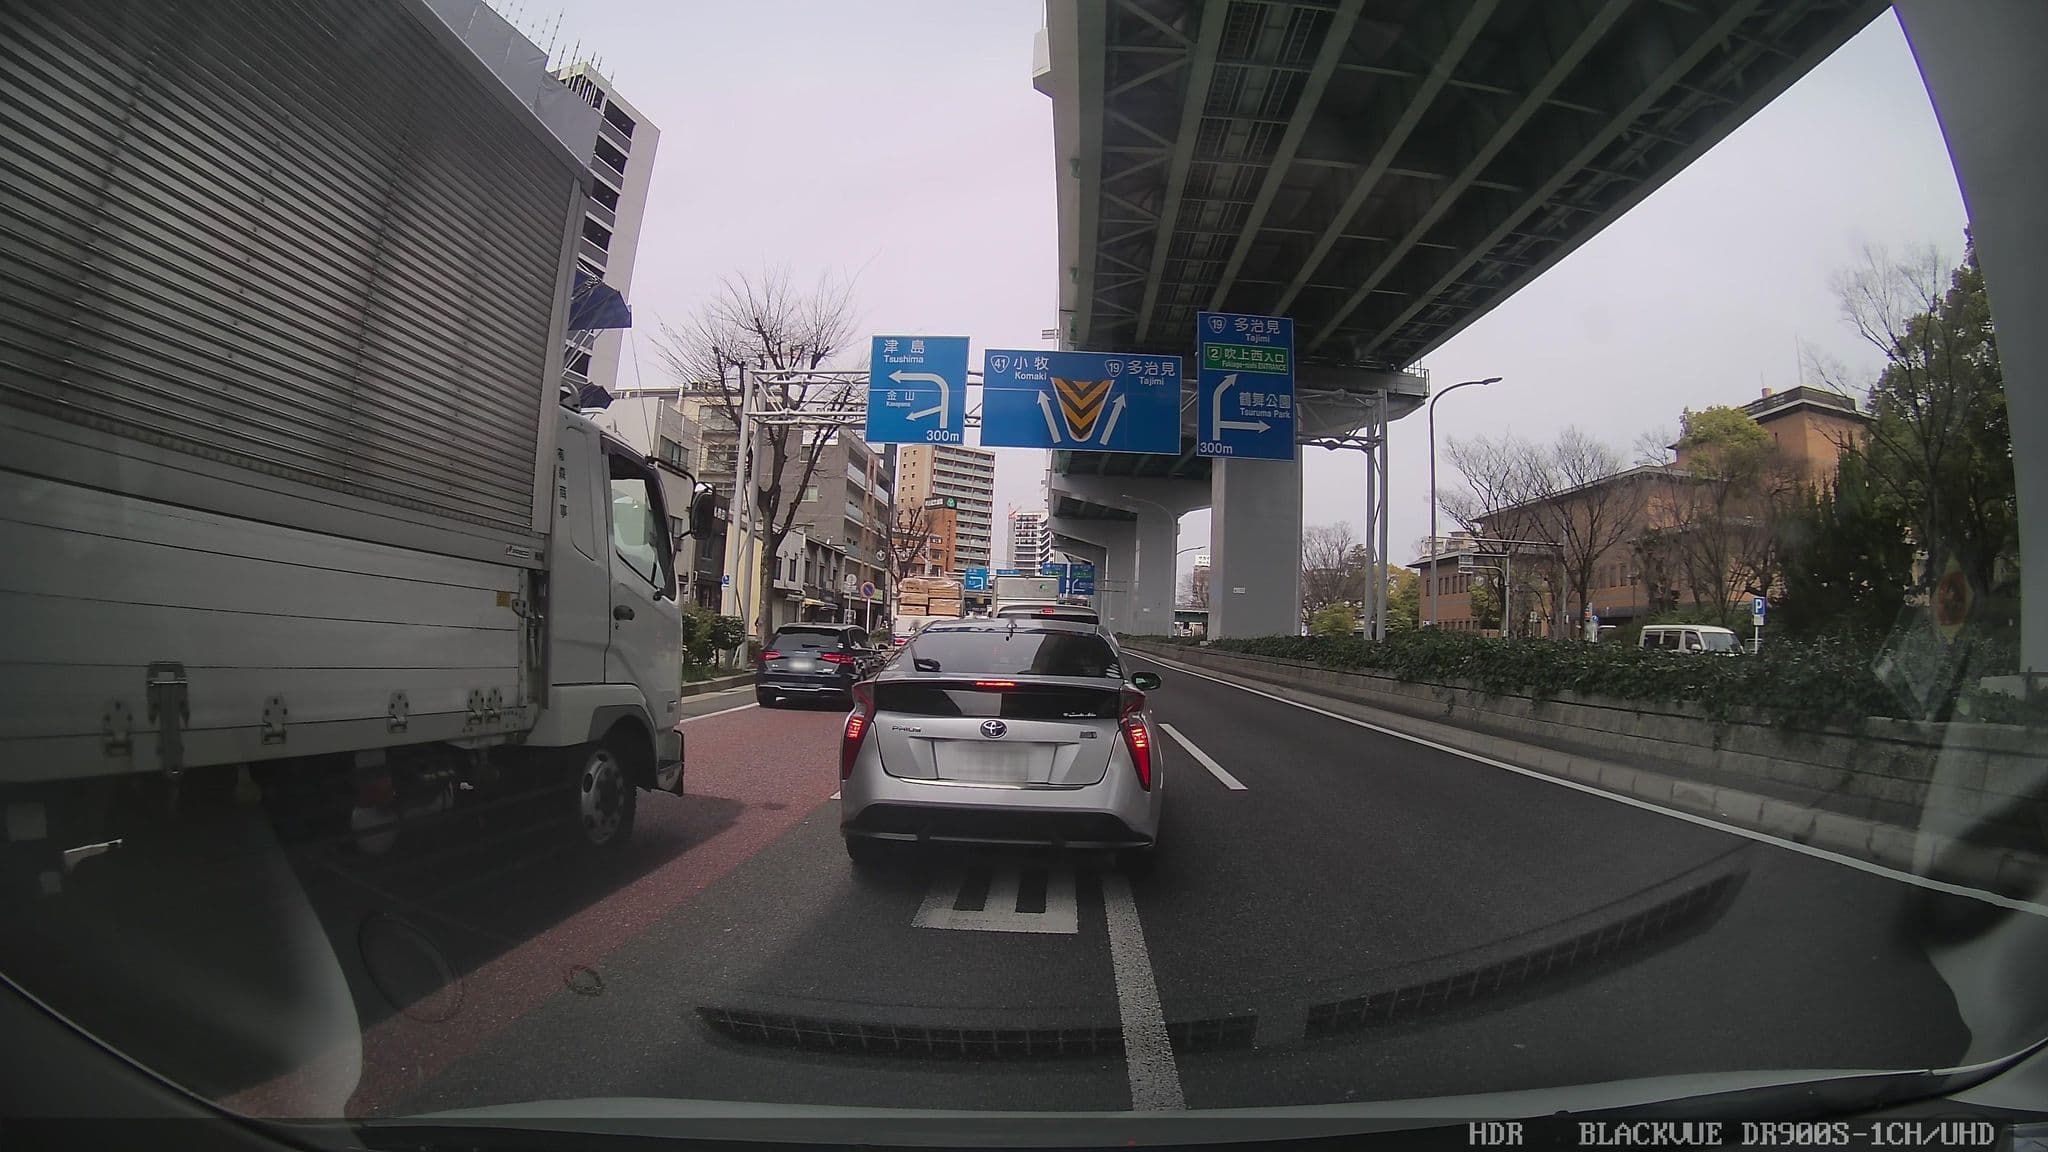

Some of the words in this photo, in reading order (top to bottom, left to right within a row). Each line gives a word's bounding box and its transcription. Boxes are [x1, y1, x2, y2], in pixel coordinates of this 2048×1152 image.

[1212, 319, 1222, 329] 19
[1234, 318, 1280, 334] 多治見
[1245, 334, 1270, 343] Tajimi
[884, 340, 924, 353] 津島
[884, 355, 924, 364] Tsushima
[1224, 348, 1284, 362] 吹上西入口
[994, 357, 1006, 368] 41
[1014, 356, 1049, 371] 小牧
[1109, 362, 1120, 372] 19
[1128, 360, 1176, 376] 多治見
[1014, 372, 1047, 381] Komaki
[1139, 377, 1164, 386] Tajimi
[887, 390, 914, 400] 金山
[1240, 392, 1290, 408] 鶴舞公園
[1240, 408, 1272, 416] Tsuruma
[1274, 410, 1291, 418] Park
[926, 430, 960, 442] 300m
[1200, 442, 1232, 454] 300m
